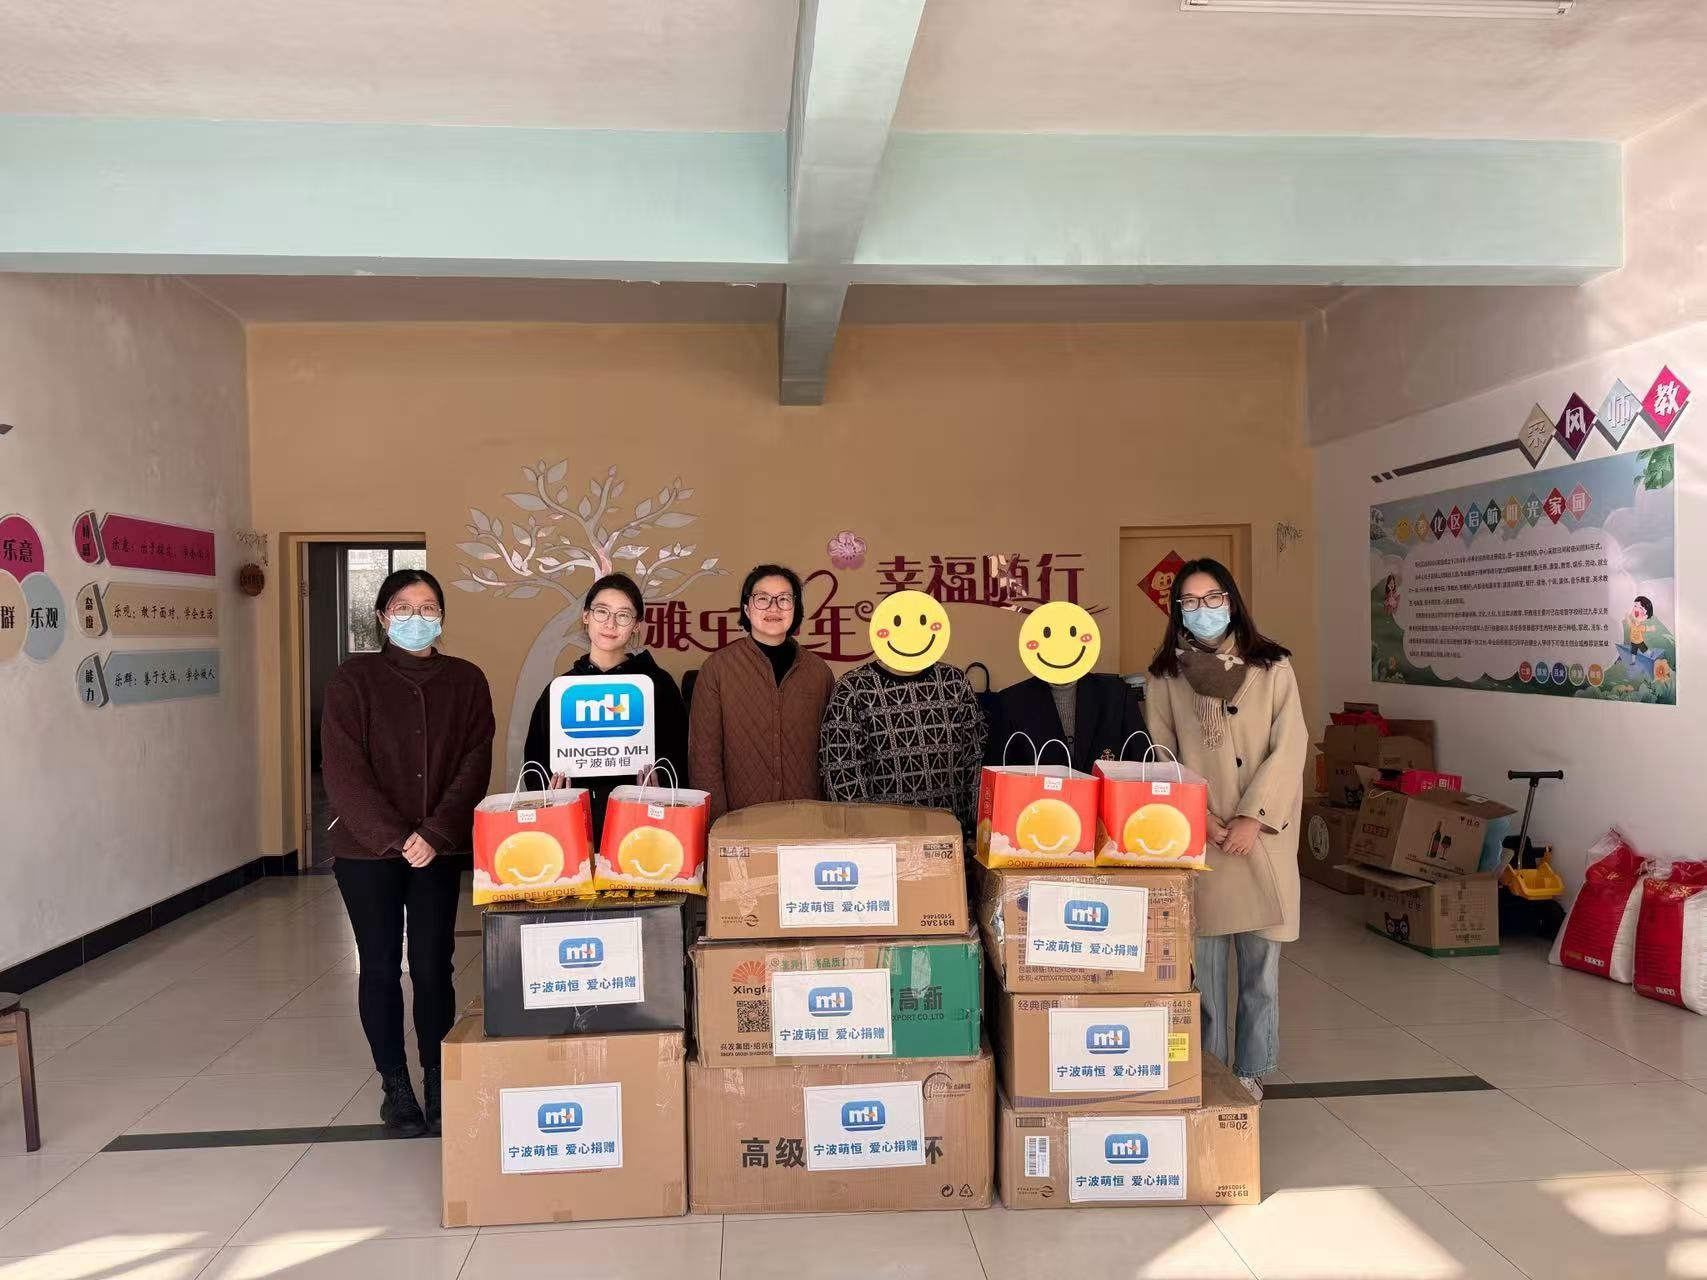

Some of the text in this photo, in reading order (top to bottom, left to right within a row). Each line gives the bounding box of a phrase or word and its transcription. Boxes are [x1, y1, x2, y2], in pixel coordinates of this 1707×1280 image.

[3, 539, 33, 563] 乐意
[875, 552, 1086, 606] 幸福随行
[30, 607, 58, 629] 乐观
[644, 570, 873, 661] 雅乐年
[85, 669, 95, 702] 能力
[557, 745, 649, 757] NINGBO MH
[575, 756, 631, 768] 宁波萌恒
[524, 888, 576, 898] DELICIOUS
[787, 901, 889, 913] 宁波萌恒 爱心捐赠
[920, 918, 955, 927] B913AC
[1034, 940, 1138, 956] 宁波萌恒 爱心捐赠
[530, 976, 635, 993] 宁波萌恒 爱心捐赠
[892, 985, 944, 1011] 高新
[780, 1028, 884, 1040] 宁波萌恒 爱心捐赠
[1057, 1065, 1160, 1077] 宁波萌恒 爱心捐赠
[509, 1141, 614, 1158] 宁波萌恒 爱心捐赠
[740, 1137, 805, 1169] 高级
[814, 1140, 917, 1155] 宁波萌恒 爱心捐赠
[1076, 1175, 1179, 1187] 宁波萌恒 爱心捐赠
[1216, 1190, 1249, 1198] B913AC
